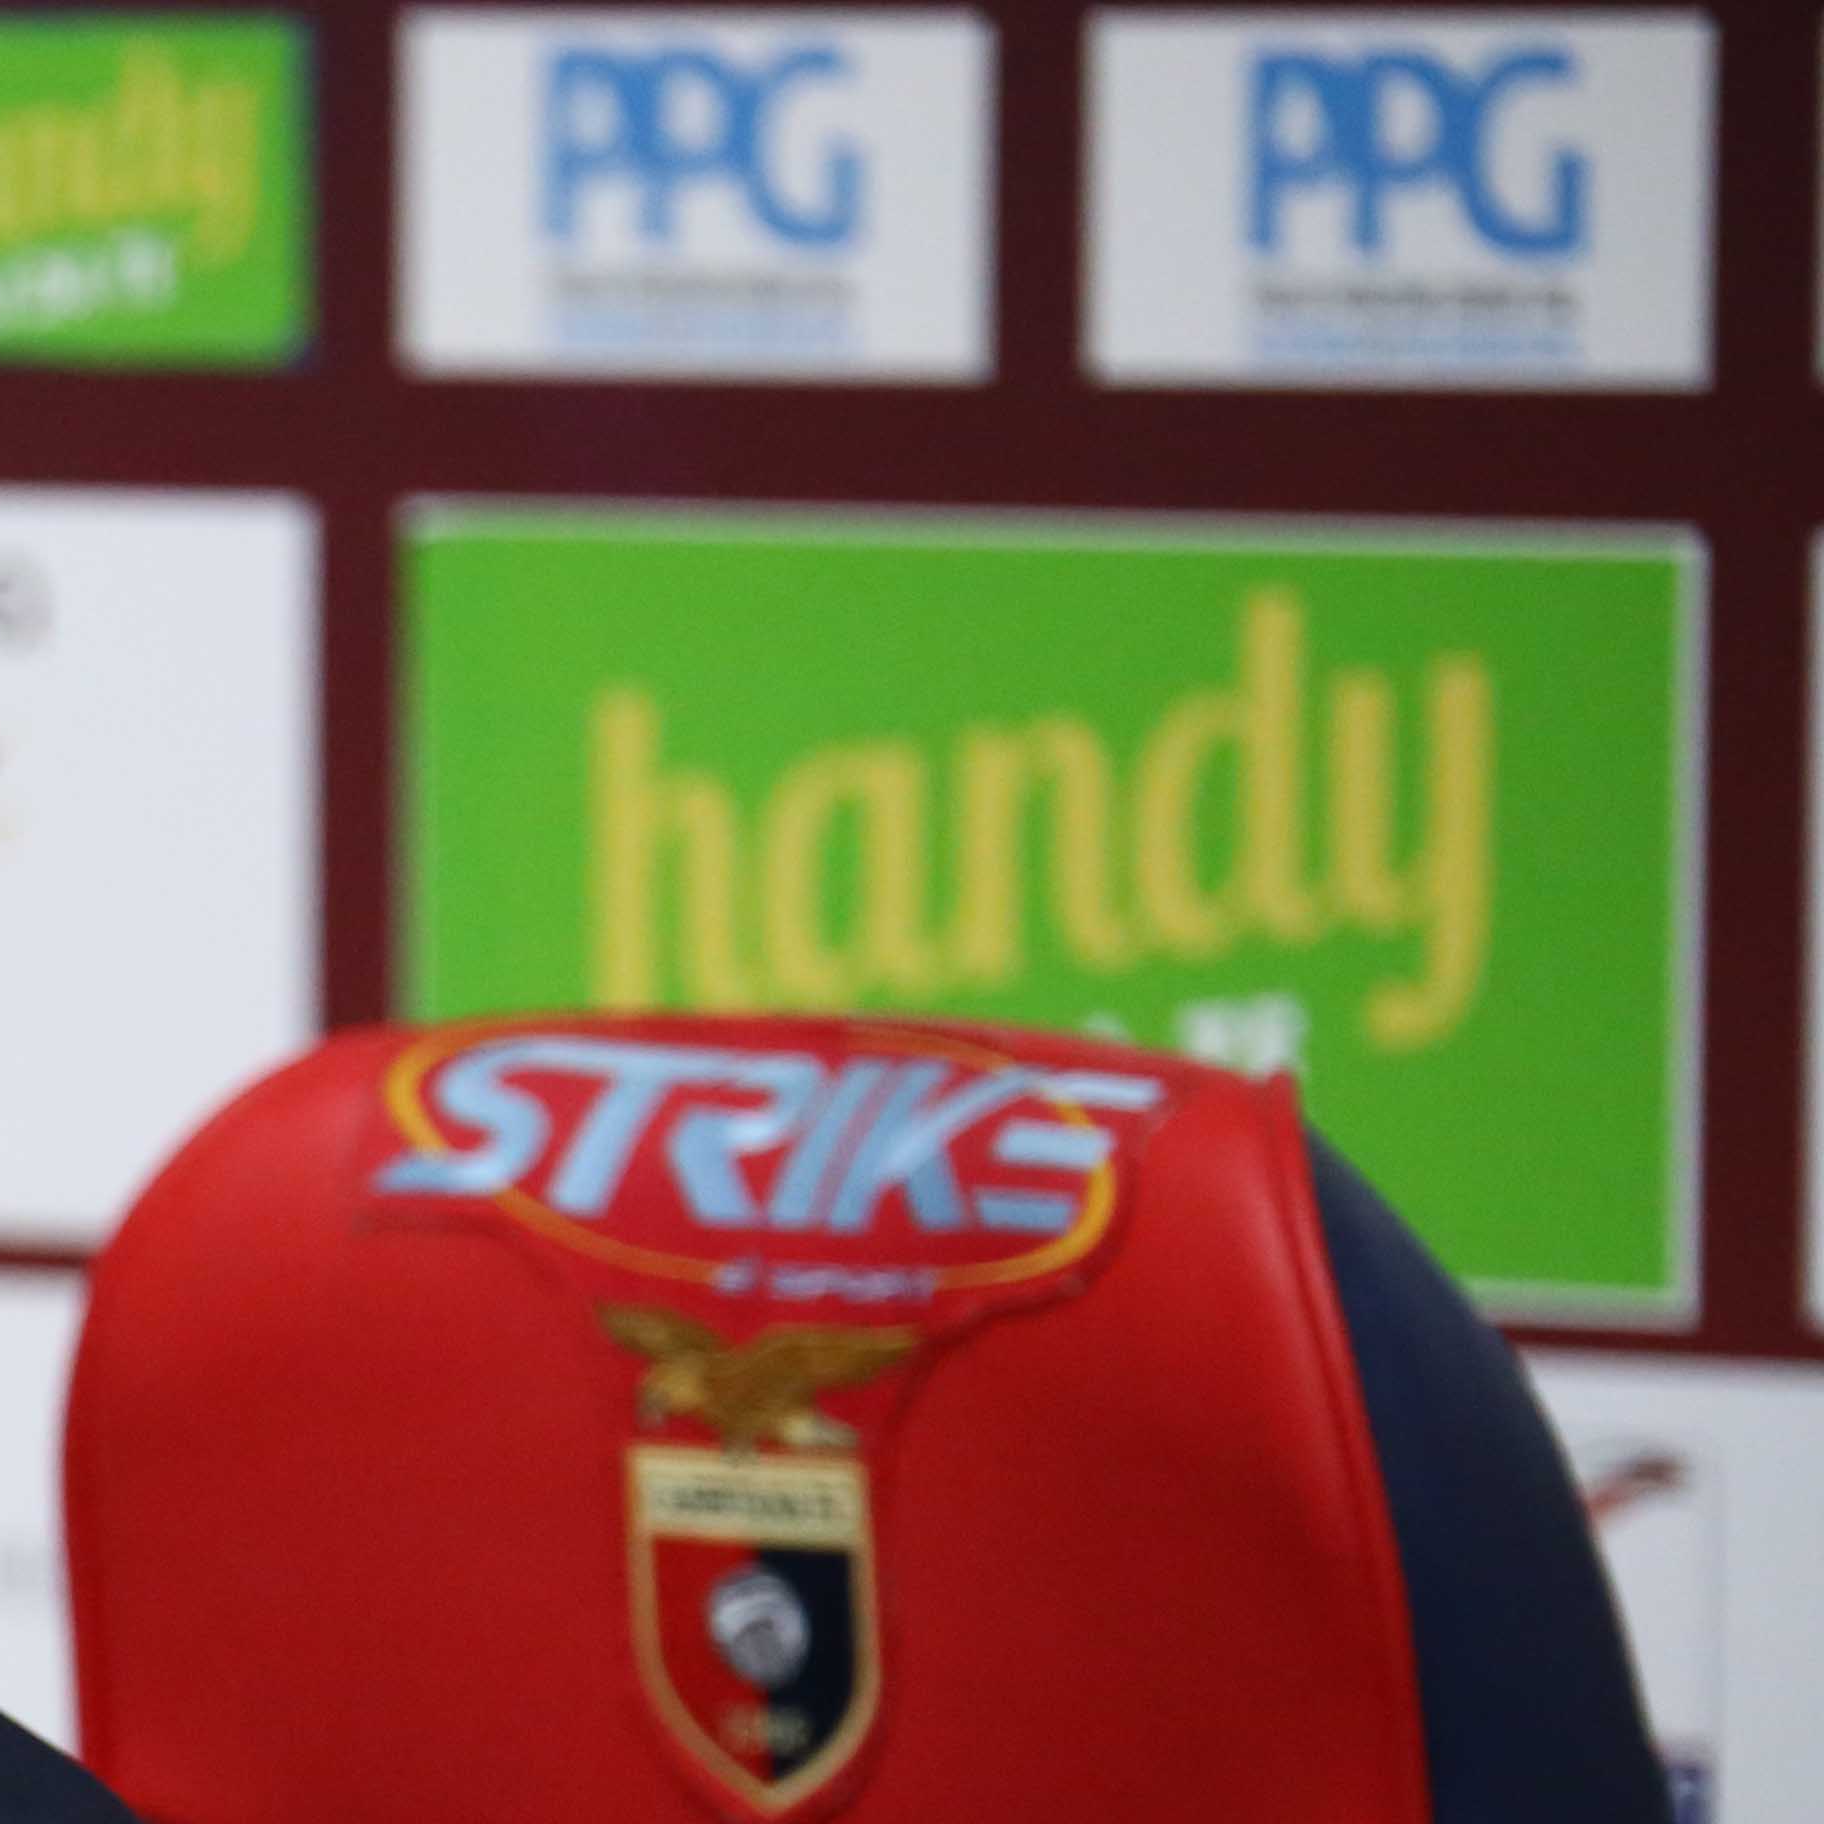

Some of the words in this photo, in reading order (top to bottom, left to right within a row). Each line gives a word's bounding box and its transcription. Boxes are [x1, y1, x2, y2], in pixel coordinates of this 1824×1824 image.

[542, 45, 860, 248] PPG
[1246, 48, 1586, 258] PPG
[586, 585, 1496, 1053] handy
[374, 1036, 1162, 1234] STRIKE
